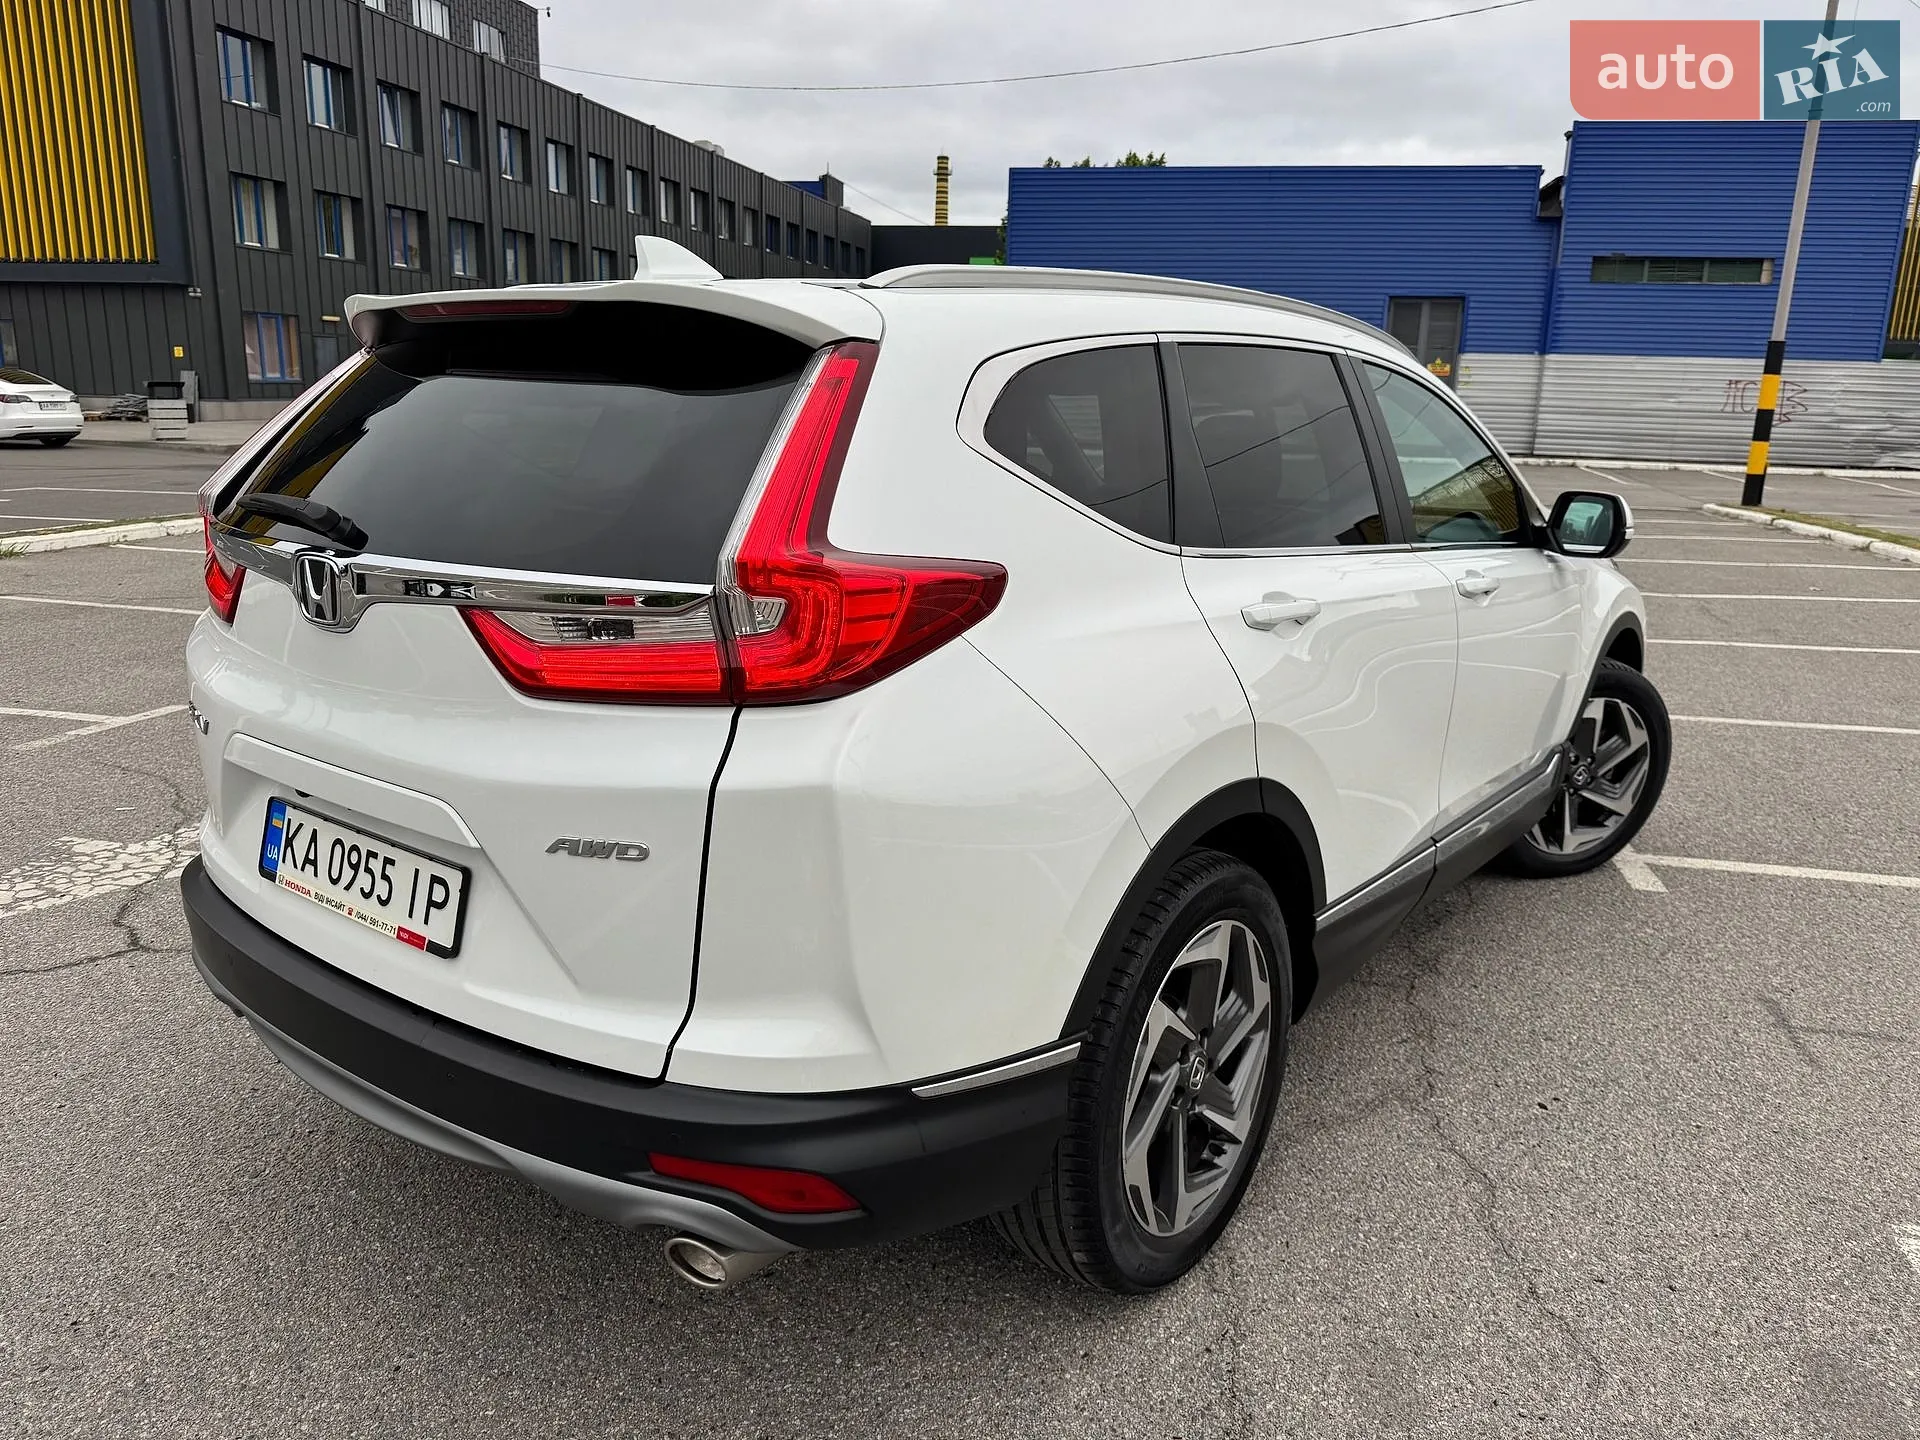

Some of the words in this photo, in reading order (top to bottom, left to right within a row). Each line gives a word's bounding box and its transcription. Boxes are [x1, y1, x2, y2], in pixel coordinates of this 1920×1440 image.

[267, 843, 279, 861] UA
[545, 836, 650, 861] AWD
[281, 817, 318, 878] KA
[327, 837, 396, 907] 0955
[408, 867, 450, 926] IP
[284, 879, 312, 898] HONDA
